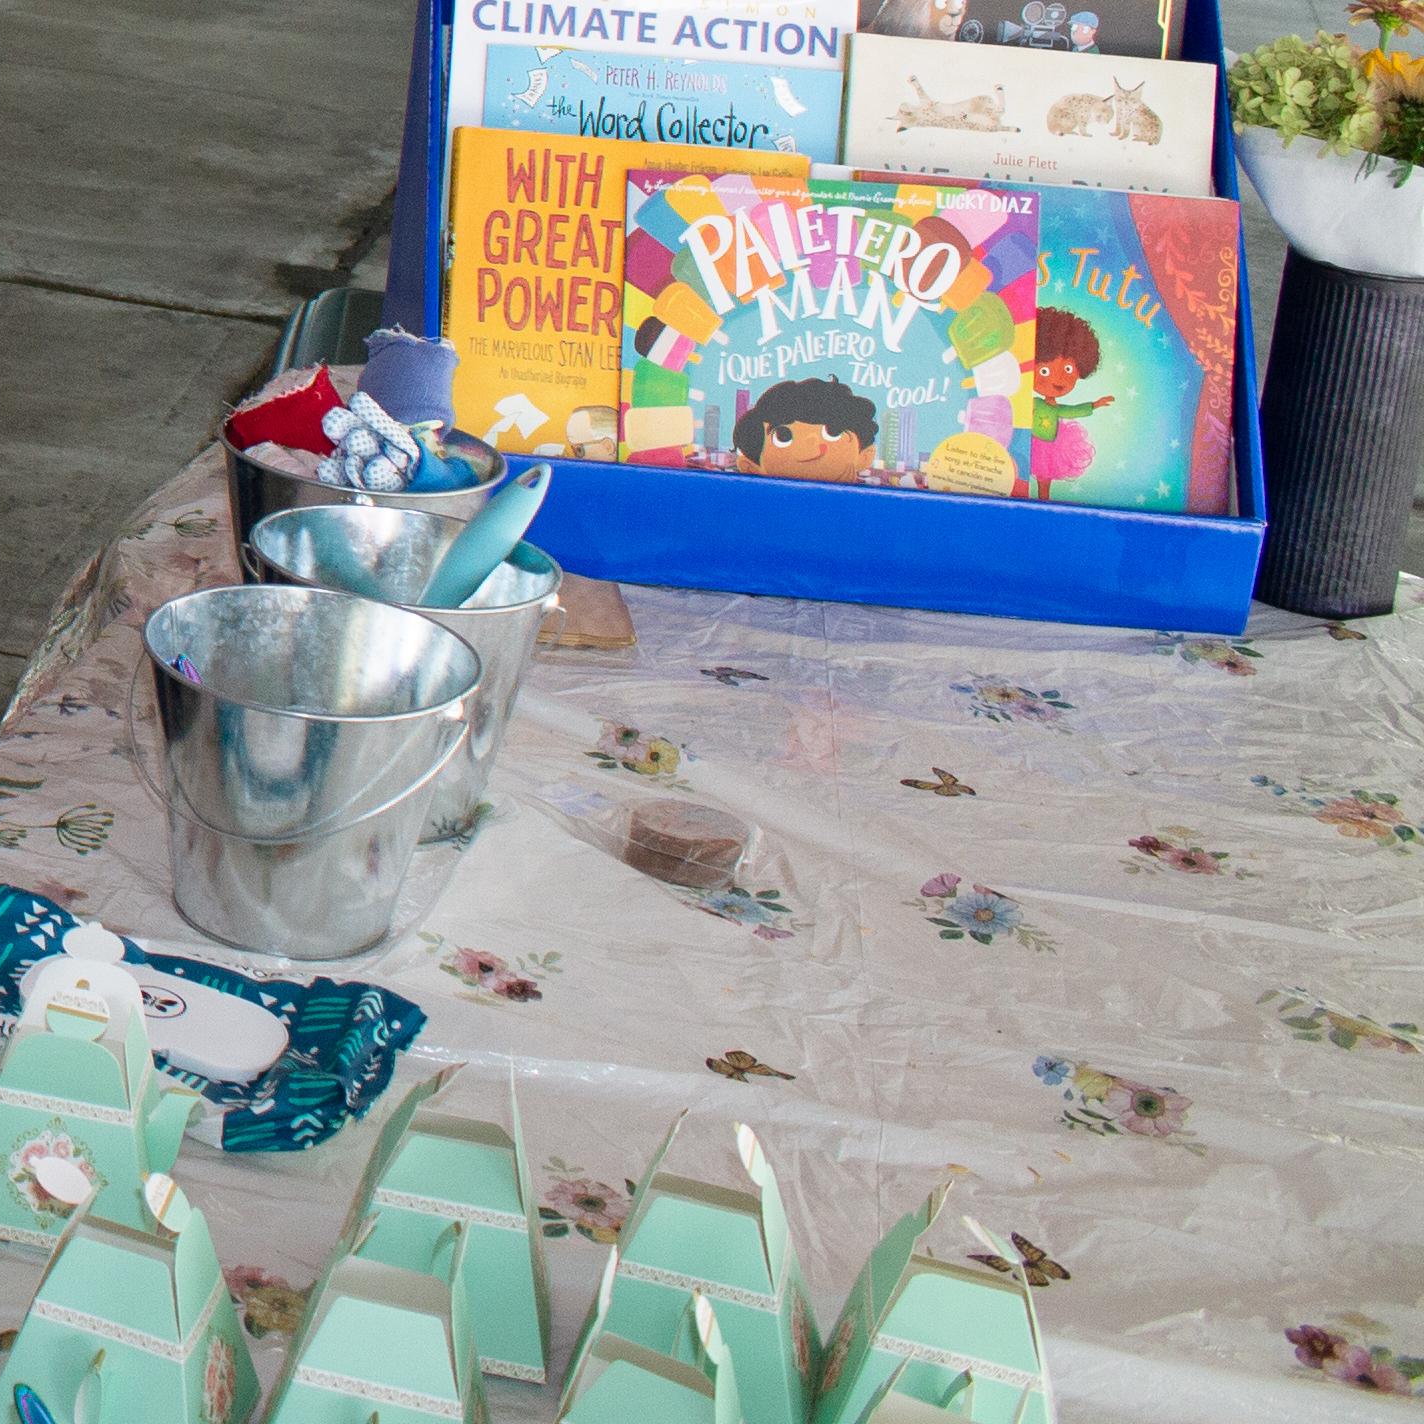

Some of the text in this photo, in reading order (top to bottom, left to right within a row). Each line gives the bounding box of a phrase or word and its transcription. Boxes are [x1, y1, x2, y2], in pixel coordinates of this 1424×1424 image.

[472, 0, 839, 59] CLIMATE ACTION
[605, 64, 729, 95] PETER H. REYNOLDS
[546, 94, 770, 149] the Word Collector
[506, 147, 605, 209] WITH
[992, 153, 1059, 170] Julie Flett
[935, 191, 1034, 216] LUCKY DIAZ
[483, 208, 622, 274] GREAT
[679, 203, 961, 316] PALETERO
[477, 267, 621, 338] POWER
[750, 258, 942, 353] MAN
[1068, 248, 1162, 329] Tutu
[469, 337, 595, 367] THE MARVELOUS STAN
[774, 330, 876, 368] PALETERO
[555, 370, 588, 388] Biography
[848, 362, 898, 388] TAN
[887, 376, 951, 408] COOL!
